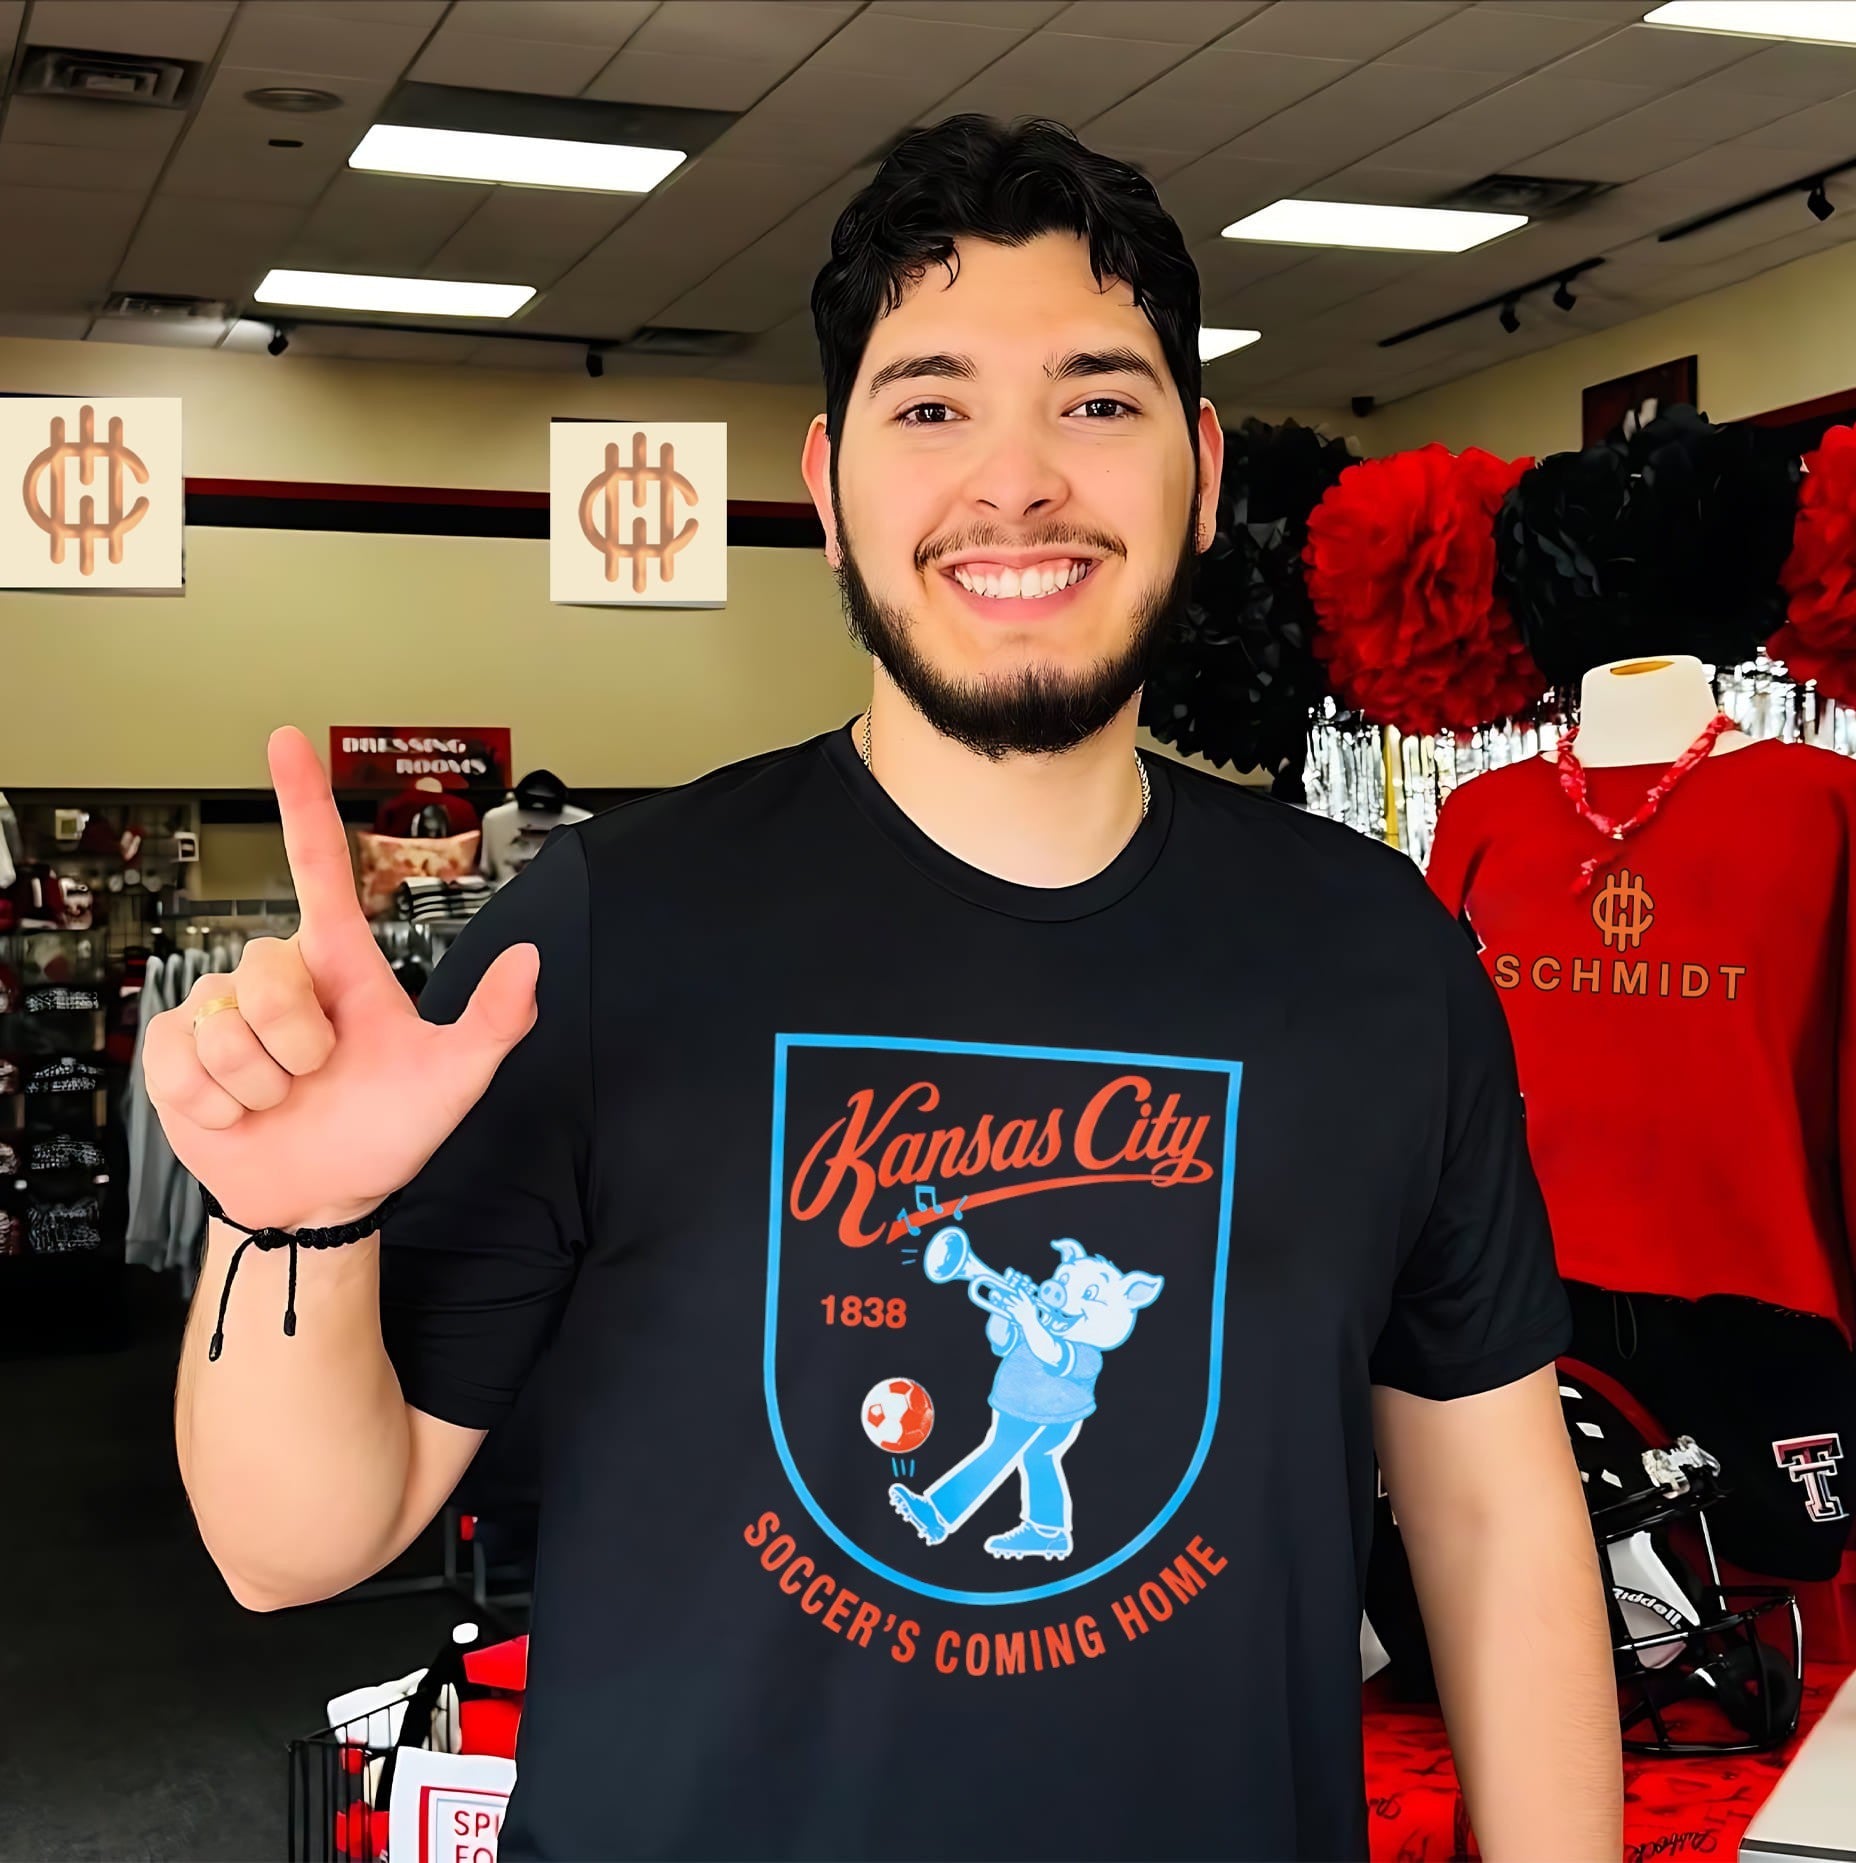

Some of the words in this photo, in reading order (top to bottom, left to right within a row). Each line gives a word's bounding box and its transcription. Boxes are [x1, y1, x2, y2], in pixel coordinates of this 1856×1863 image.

[341, 737, 467, 754] DRESSING
[396, 758, 487, 775] ROOMS
[1493, 953, 1747, 1000] SCHMIDT
[790, 1081, 1063, 1248] Kansas
[1073, 1075, 1214, 1188] City
[821, 1295, 907, 1329] 1838
[743, 1511, 920, 1663] SOCCER'S
[935, 1615, 1106, 1677] COMING
[1111, 1535, 1228, 1641] HOME
